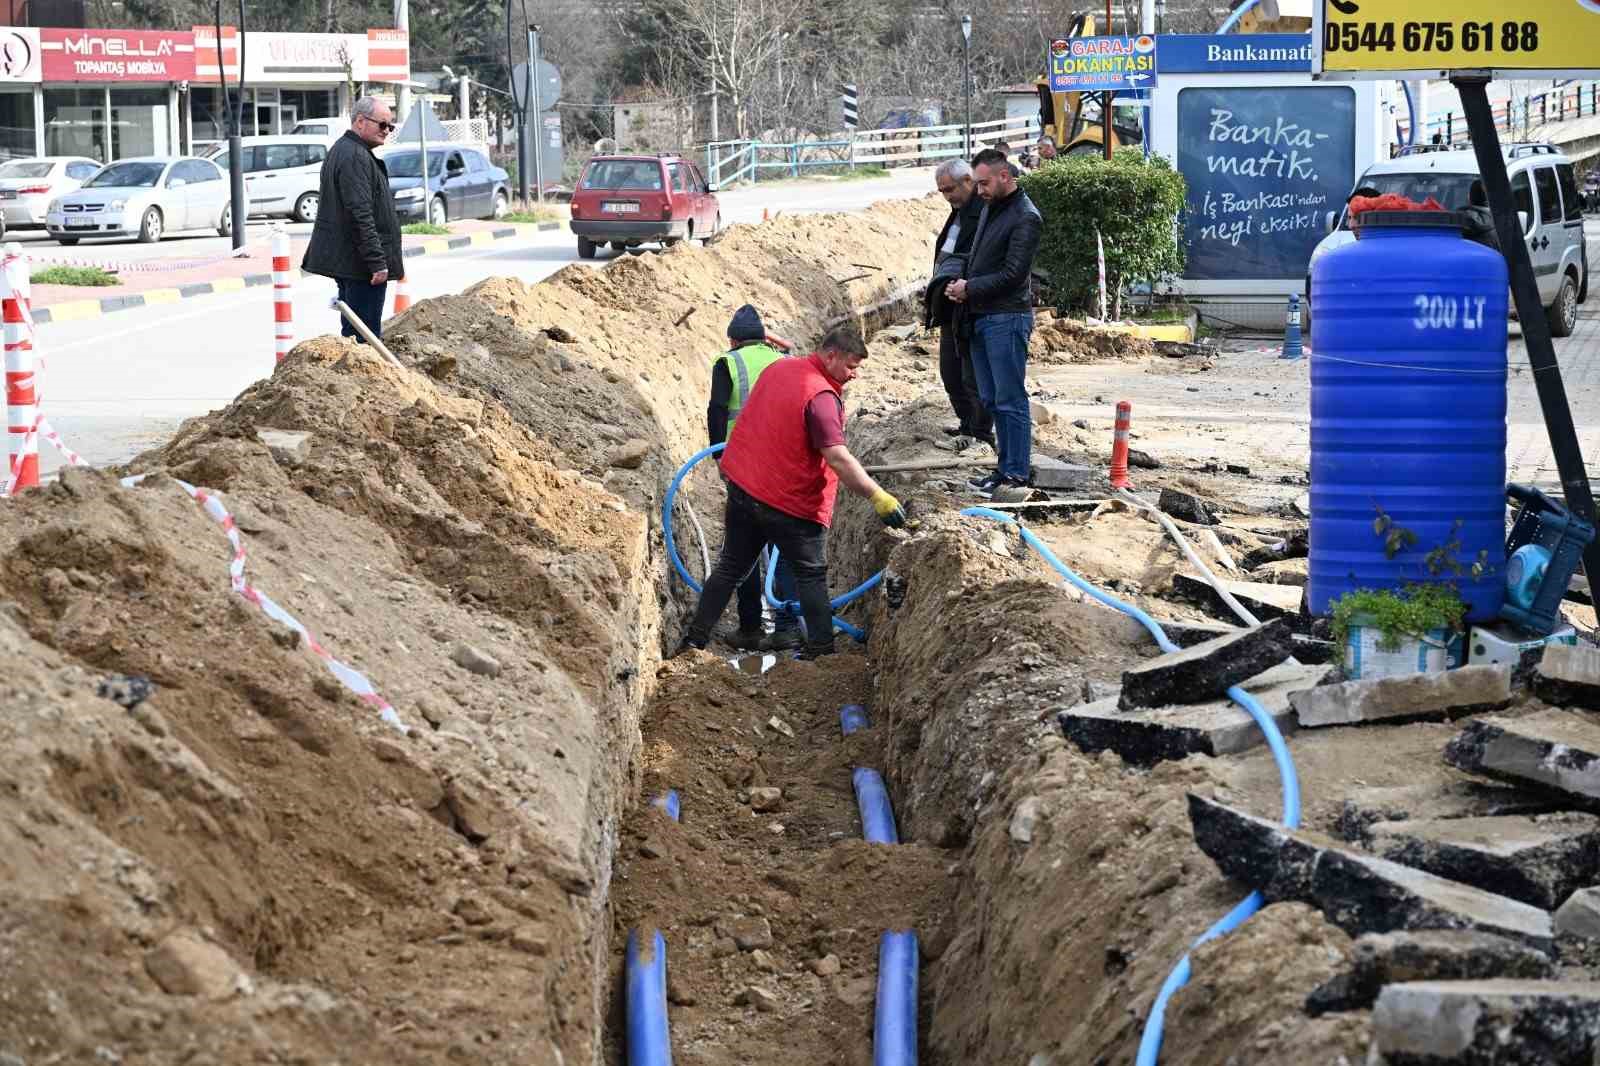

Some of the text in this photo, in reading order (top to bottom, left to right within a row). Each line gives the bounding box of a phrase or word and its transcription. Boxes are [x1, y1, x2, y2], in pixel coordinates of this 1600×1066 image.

[1072, 39, 1134, 56] GARAJ
[1325, 22, 1538, 51] 0544 675 61 88
[1053, 56, 1153, 74] LOKANTASI
[1208, 44, 1312, 61] Bankamati
[74, 60, 166, 76] TOPANTAŞ MOBİLYA
[1208, 108, 1329, 148] Banka-
[1207, 150, 1319, 181] matik.
[1203, 191, 1326, 219] İş Bankası'ndan
[1201, 211, 1318, 247] neyi eksik!
[1414, 295, 1487, 329] 300 LT
